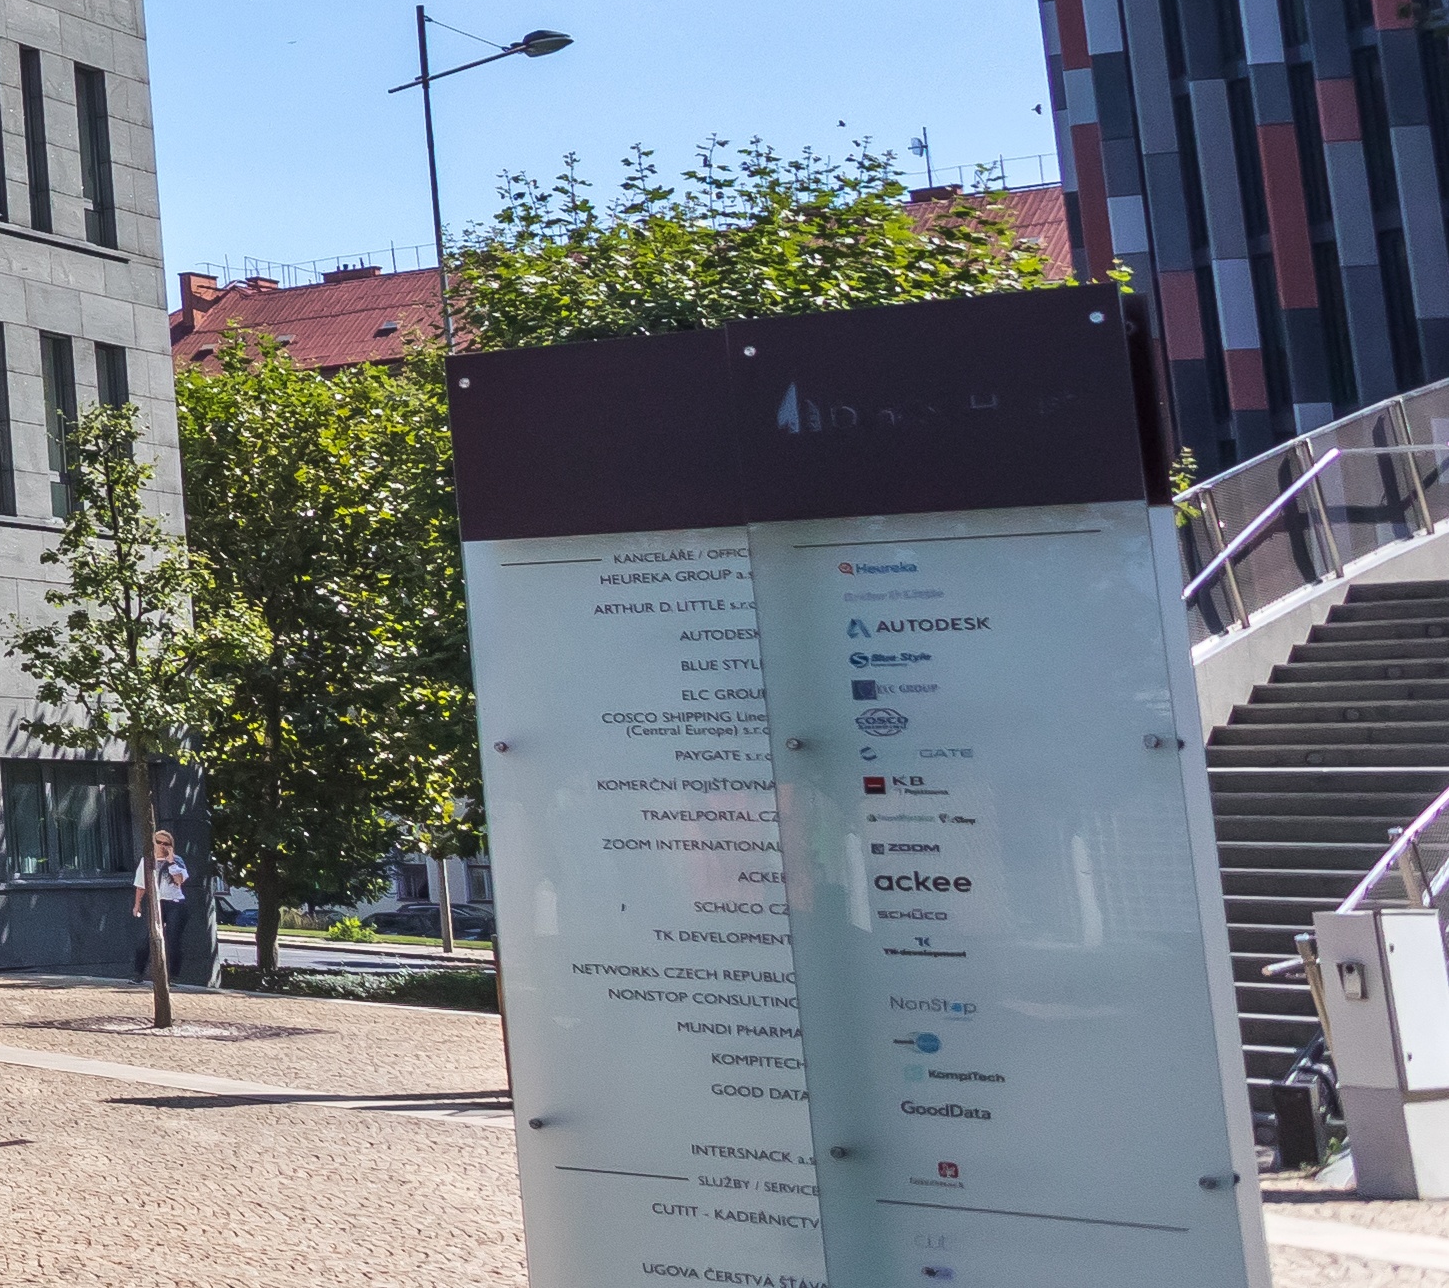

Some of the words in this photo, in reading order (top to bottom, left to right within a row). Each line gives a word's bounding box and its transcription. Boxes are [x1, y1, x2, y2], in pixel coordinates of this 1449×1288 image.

[706, 548, 751, 559] OFFIC
[856, 562, 918, 574] Heureka
[600, 573, 672, 585] HEUREKA
[675, 569, 732, 582] GROUP
[594, 603, 655, 615] ARTHUR
[676, 599, 726, 612] LITTLE
[876, 616, 991, 633] AUTODESK
[681, 660, 718, 672] BLUE
[722, 658, 763, 670] STYL
[682, 689, 710, 701] ELC
[899, 683, 939, 693] GROUP
[602, 712, 657, 723] COSCO
[662, 711, 732, 723] SHIPPING
[854, 716, 908, 725] COSCO
[626, 725, 681, 738] (Central
[685, 725, 738, 738] Europe)
[675, 750, 740, 762] PAYGATE
[919, 748, 974, 758] GATE
[597, 777, 677, 791] KOMERČNÍ
[893, 776, 925, 786] KB
[602, 838, 651, 851] ZOOM
[656, 838, 783, 853] INTERNATIONAL
[888, 843, 940, 853] ZOOM
[874, 871, 972, 892] ackee
[769, 904, 791, 916] CZ
[653, 929, 675, 942] TK
[678, 930, 793, 946] DEVELOPMENT
[572, 963, 660, 979] NETWORKS
[664, 966, 718, 981] CZECH
[723, 970, 797, 985] REPUBLIC
[608, 988, 688, 1004] NONSTOP
[677, 1021, 732, 1036] MUNDI
[737, 1024, 803, 1039] PHARMA
[711, 1053, 807, 1071] KOMPITECH
[928, 1068, 1006, 1084] KompiTech
[711, 1084, 763, 1098] GOOD
[769, 1087, 811, 1102] DATA
[900, 1100, 992, 1121] GoodData
[691, 1144, 791, 1164] INTERSNACK
[698, 1174, 750, 1190] SLUŽBY
[652, 1202, 698, 1218] CUTIT
[642, 1262, 699, 1279] UGOVA
